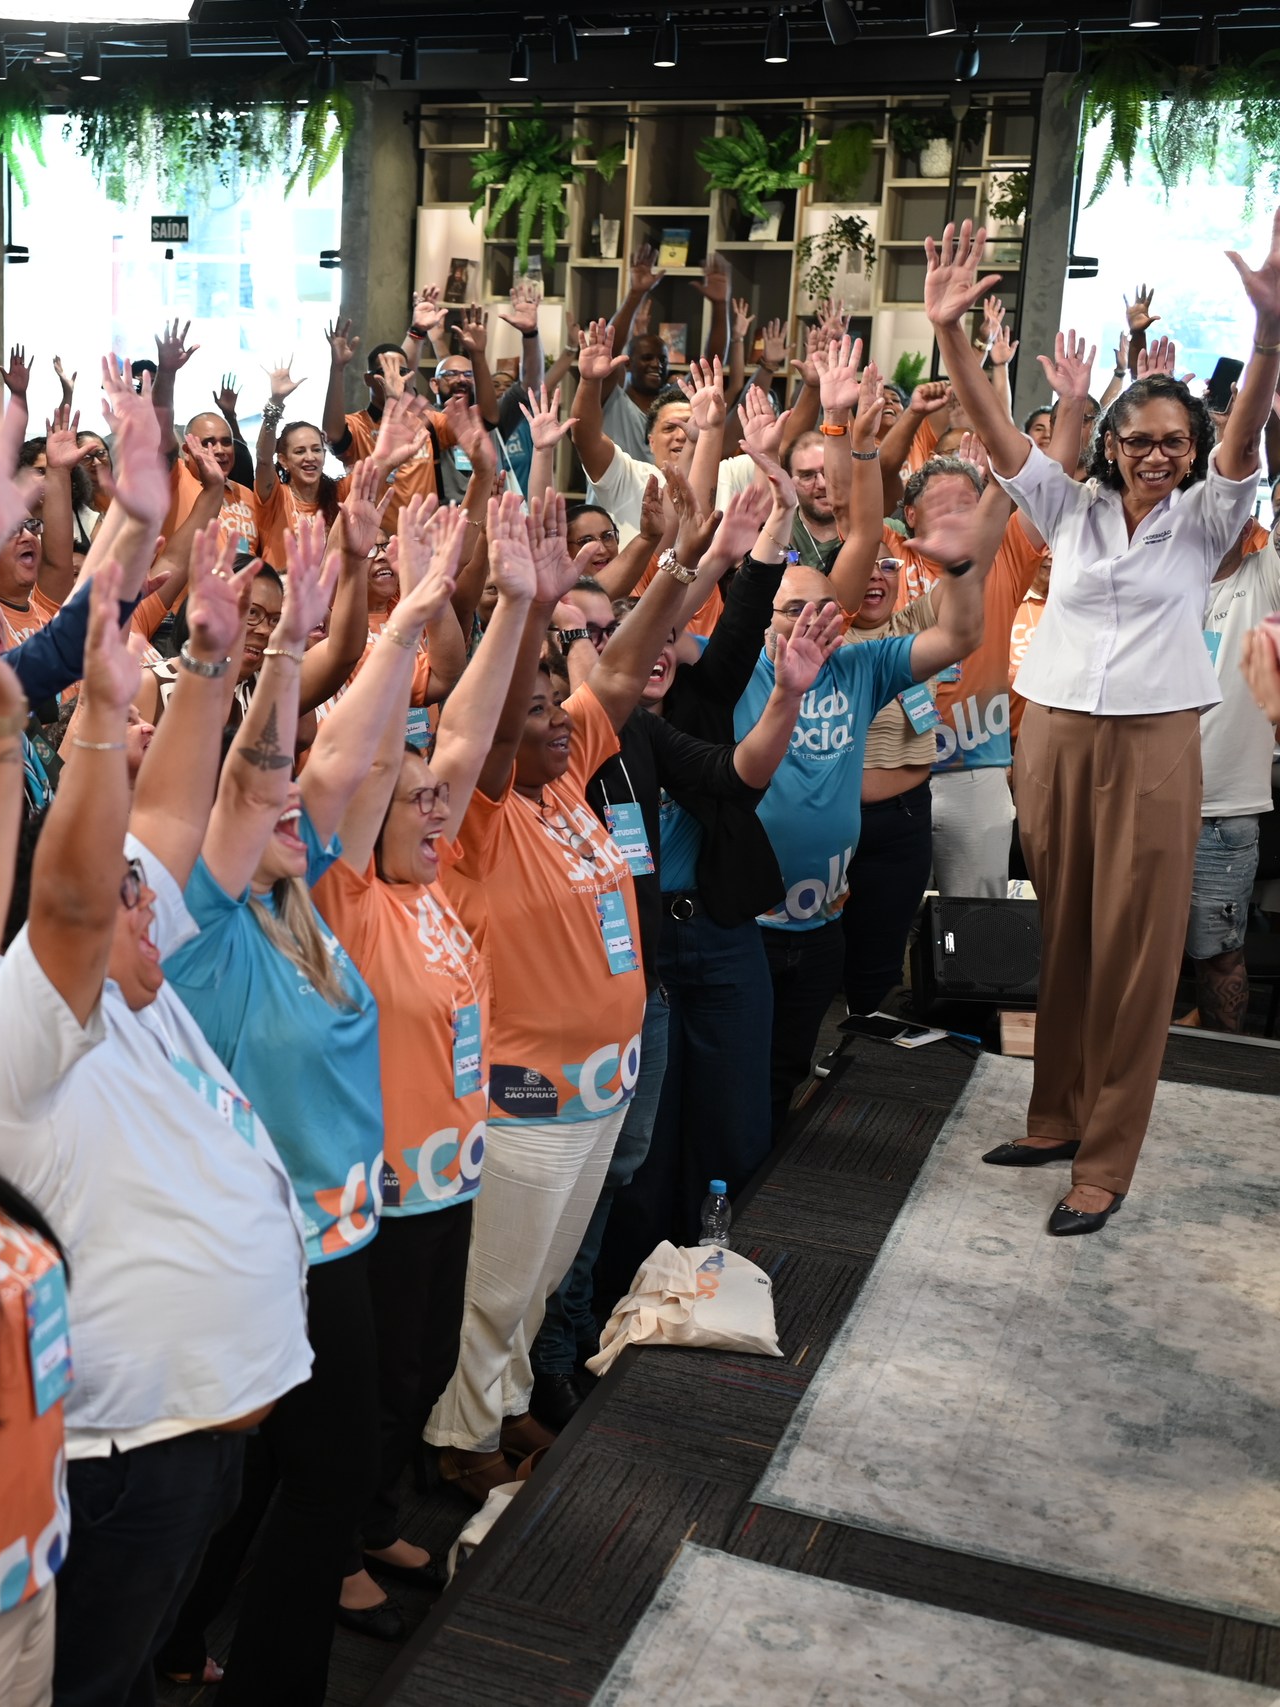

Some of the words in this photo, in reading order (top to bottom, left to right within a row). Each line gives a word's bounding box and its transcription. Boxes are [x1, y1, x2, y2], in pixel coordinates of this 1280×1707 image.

[152, 219, 188, 239] SAÍDA
[799, 686, 849, 719] llab
[802, 746, 840, 761] TERCEIRO
[614, 827, 642, 837] STUDENT
[504, 1091, 525, 1099] SÃO
